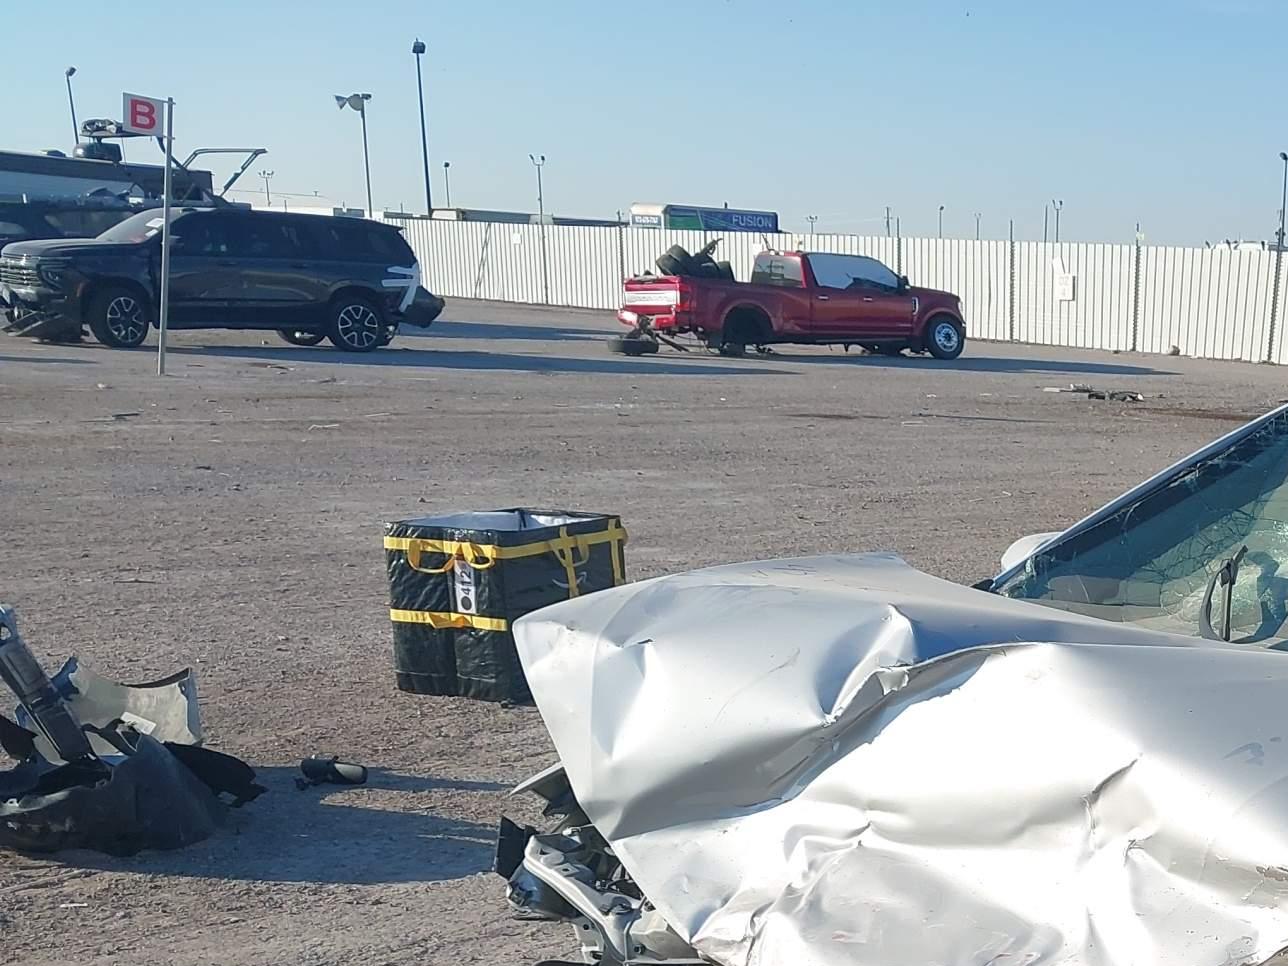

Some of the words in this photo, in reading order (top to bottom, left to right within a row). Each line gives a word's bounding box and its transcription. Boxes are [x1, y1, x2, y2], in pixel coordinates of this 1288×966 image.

[130, 98, 156, 130] B
[732, 215, 772, 228] FUSION
[462, 570, 472, 597] 412
